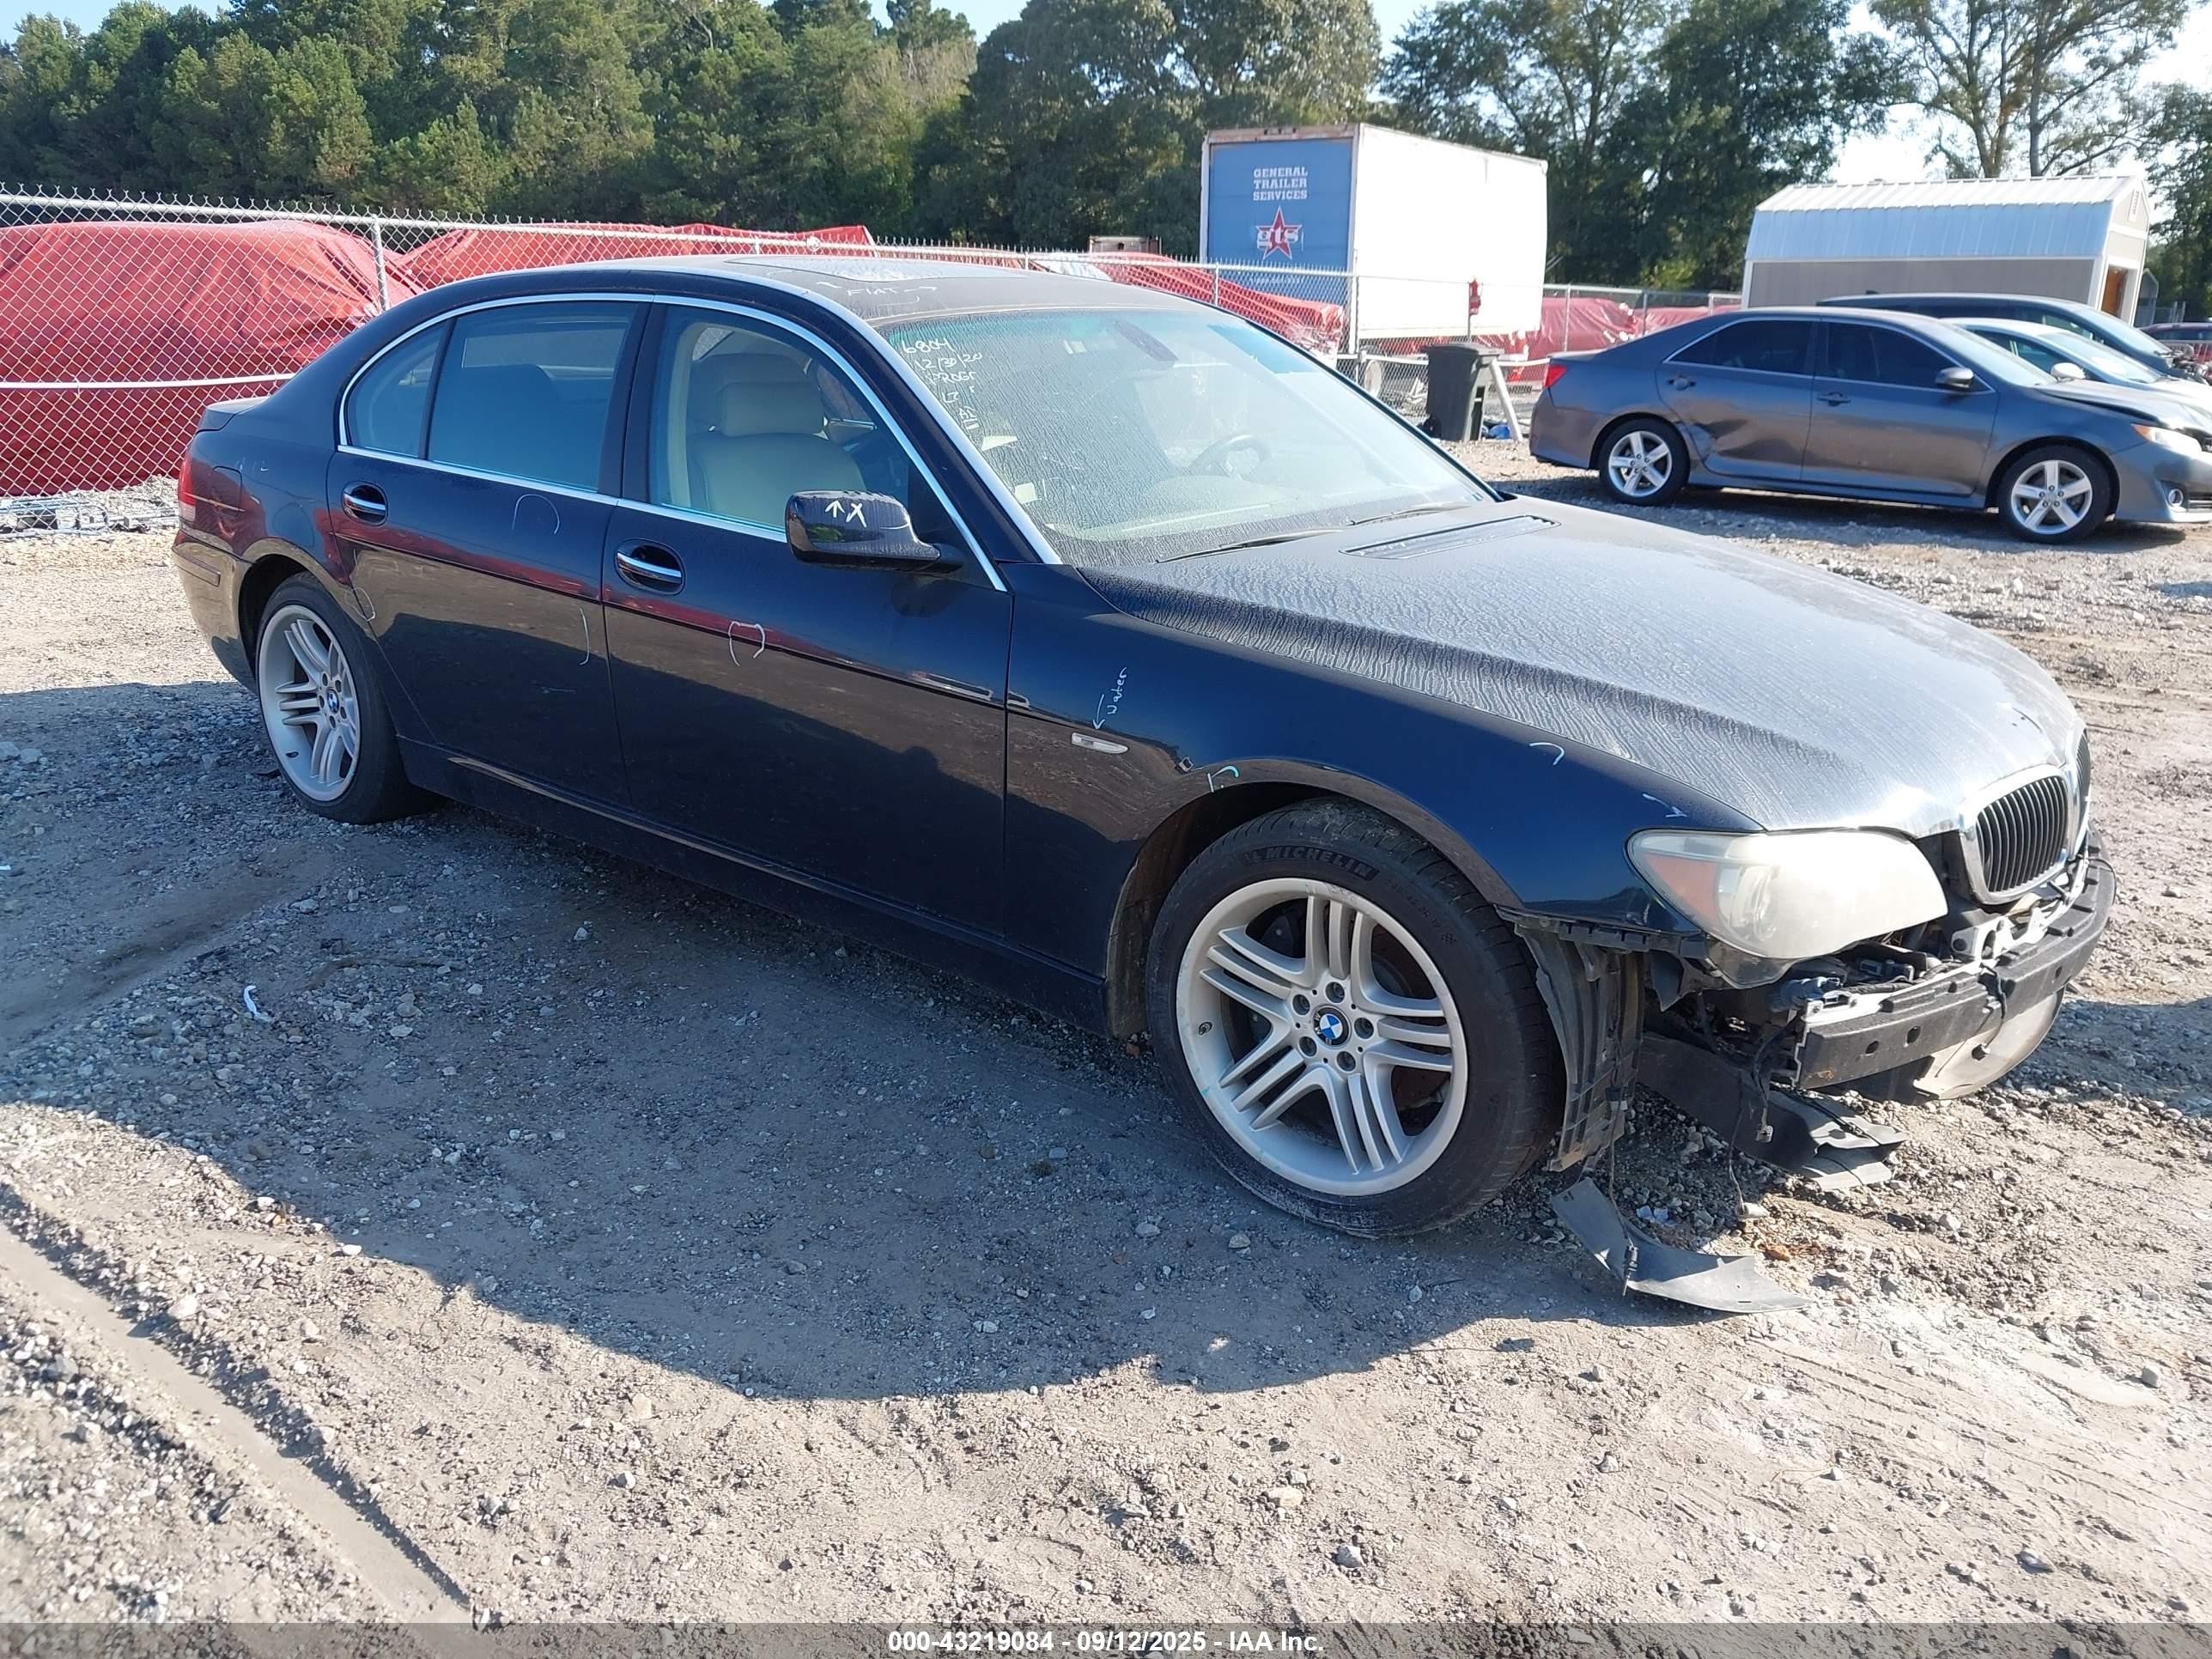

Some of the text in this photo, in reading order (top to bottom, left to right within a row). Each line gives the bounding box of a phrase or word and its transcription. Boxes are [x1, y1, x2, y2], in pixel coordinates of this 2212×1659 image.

[1254, 167, 1308, 178] GENERAL
[1254, 178, 1307, 190] TRAILER
[1253, 189, 1307, 201] SERVICES
[1266, 847, 1375, 878] MICHELIN
